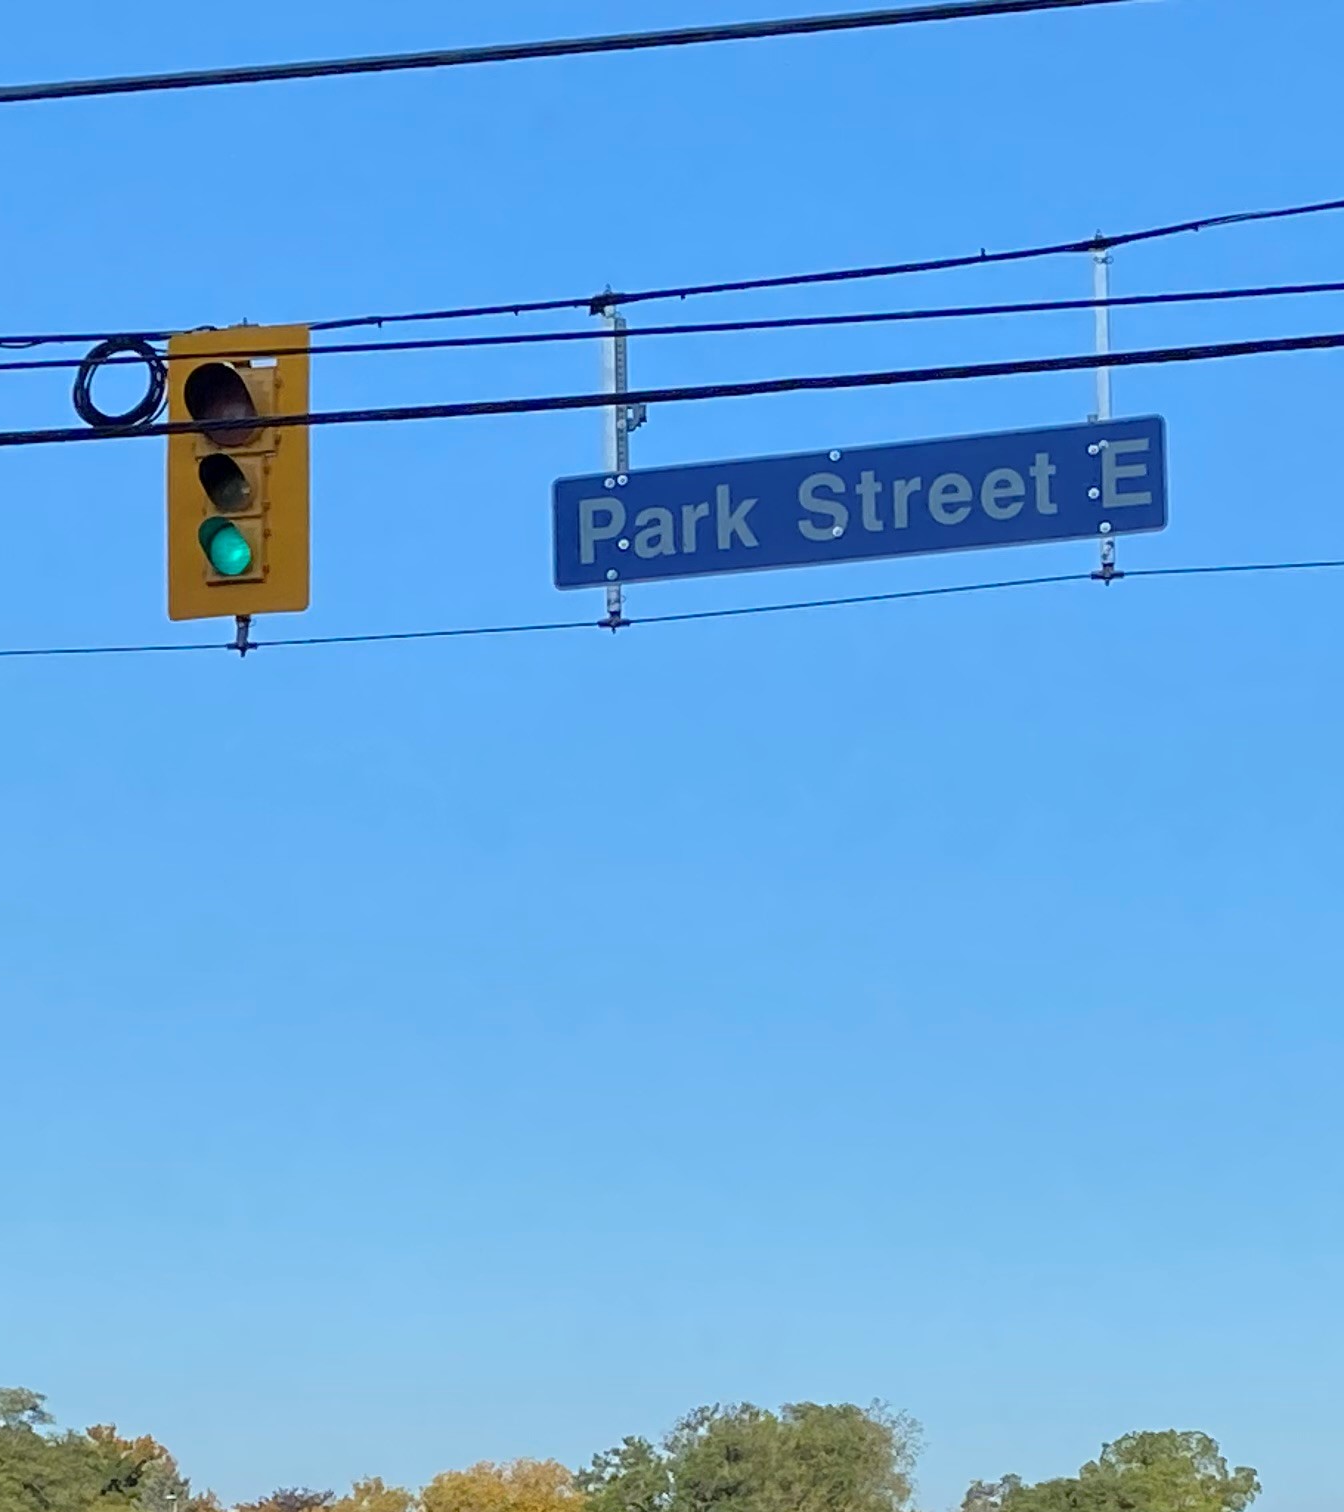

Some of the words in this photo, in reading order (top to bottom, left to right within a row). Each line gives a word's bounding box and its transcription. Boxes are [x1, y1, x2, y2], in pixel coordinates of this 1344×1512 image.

[578, 483, 759, 564] Park
[797, 451, 1058, 541] Street
[1101, 437, 1153, 508] E
